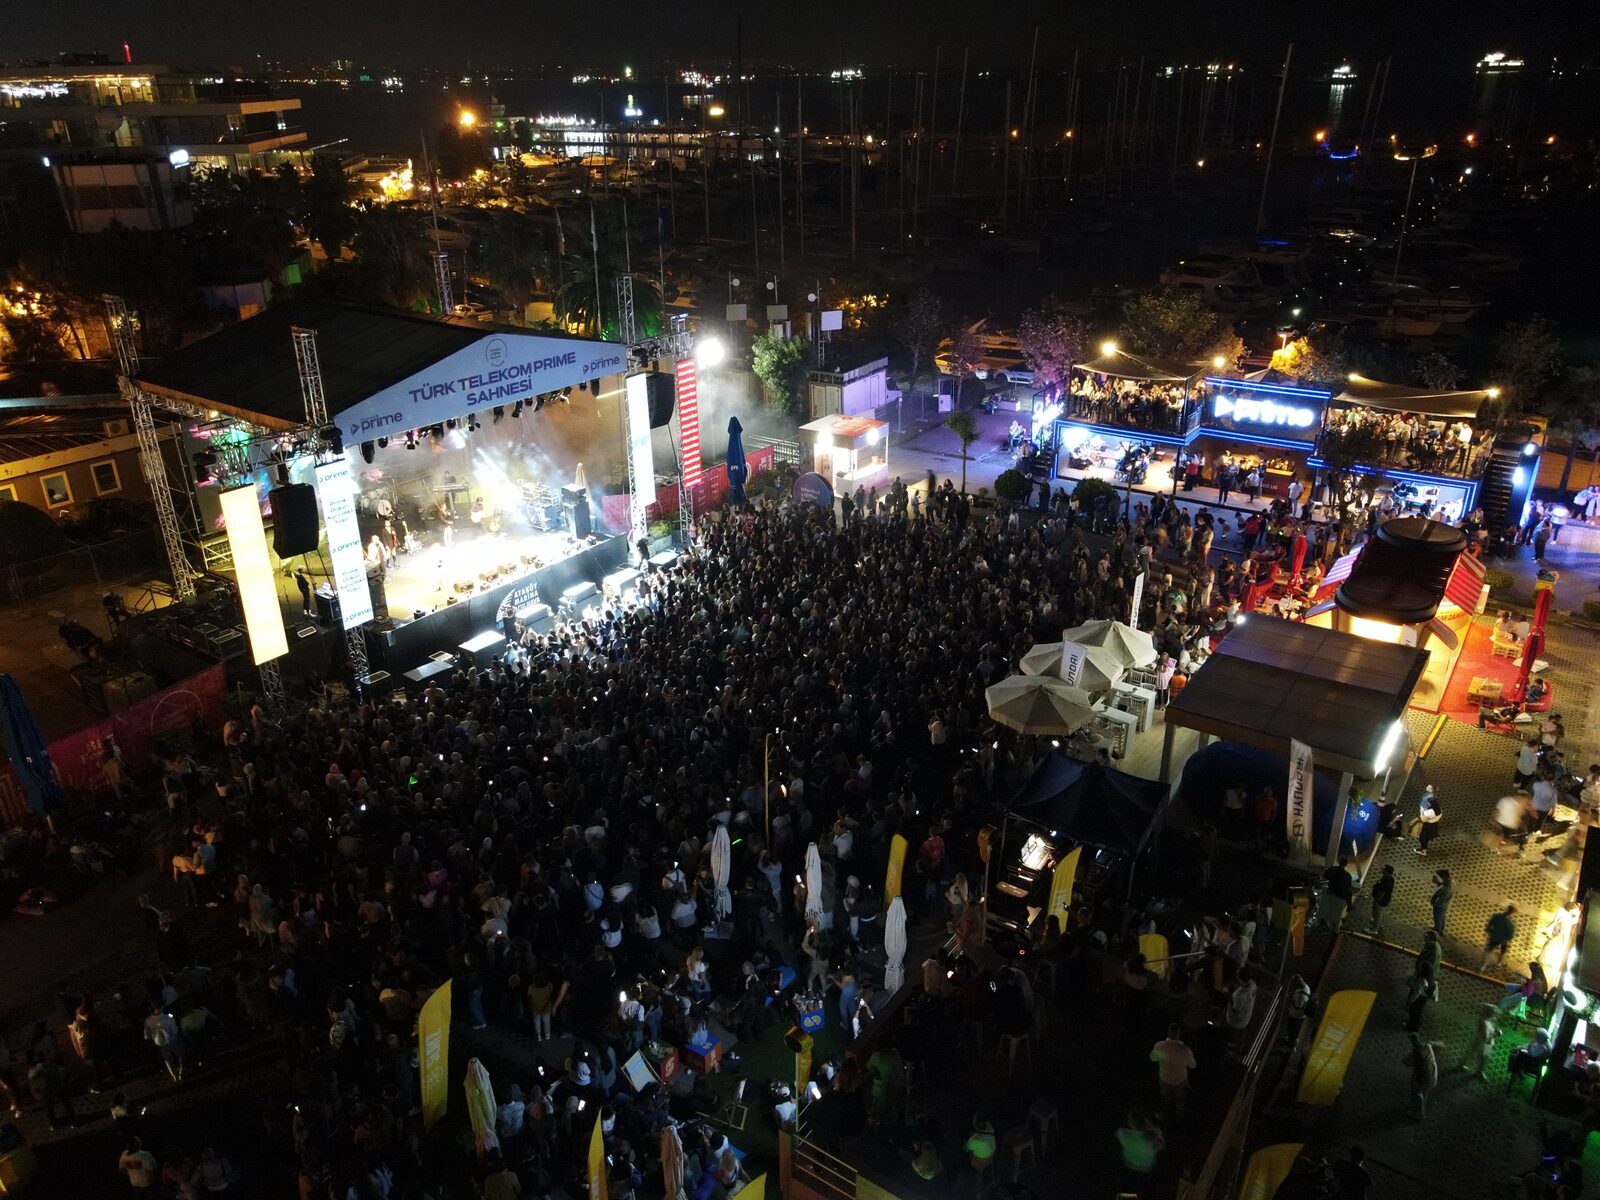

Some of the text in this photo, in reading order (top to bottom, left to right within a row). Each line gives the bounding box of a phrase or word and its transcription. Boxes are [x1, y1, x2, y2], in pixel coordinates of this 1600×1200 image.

[409, 352, 576, 403] TÜRK TELEKOM PRIME
[590, 356, 620, 374] prime
[467, 375, 532, 406] SAHNESİ
[362, 411, 403, 433] prime
[1233, 399, 1313, 427] prime
[1066, 654, 1078, 686] UNDAI
